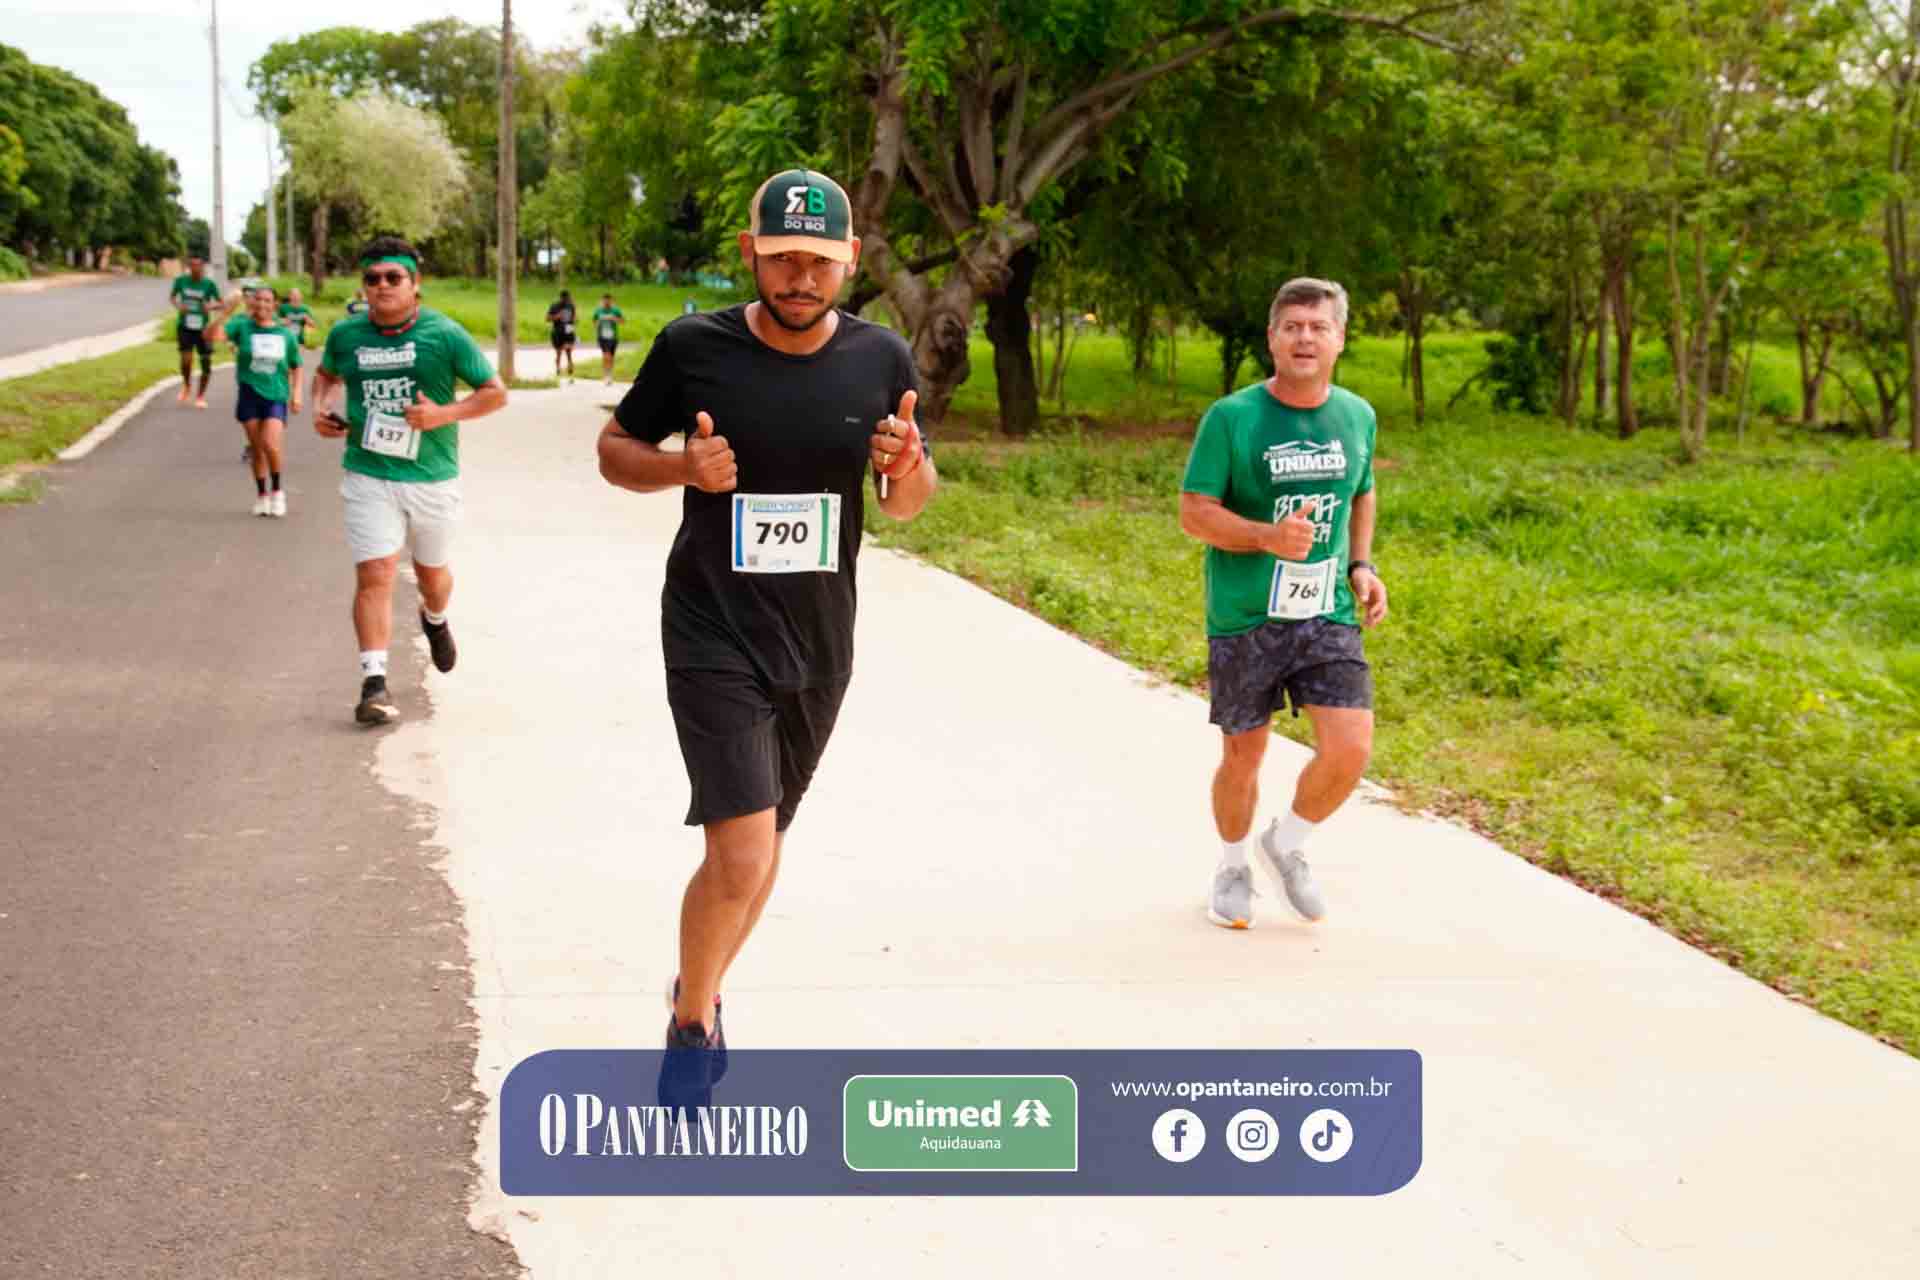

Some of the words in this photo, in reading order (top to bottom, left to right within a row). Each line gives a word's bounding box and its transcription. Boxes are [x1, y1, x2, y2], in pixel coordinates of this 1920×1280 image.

[376, 427, 404, 442] 437
[1269, 453, 1346, 475] UNIMED
[755, 521, 809, 545] 790
[1287, 581, 1321, 600] 766
